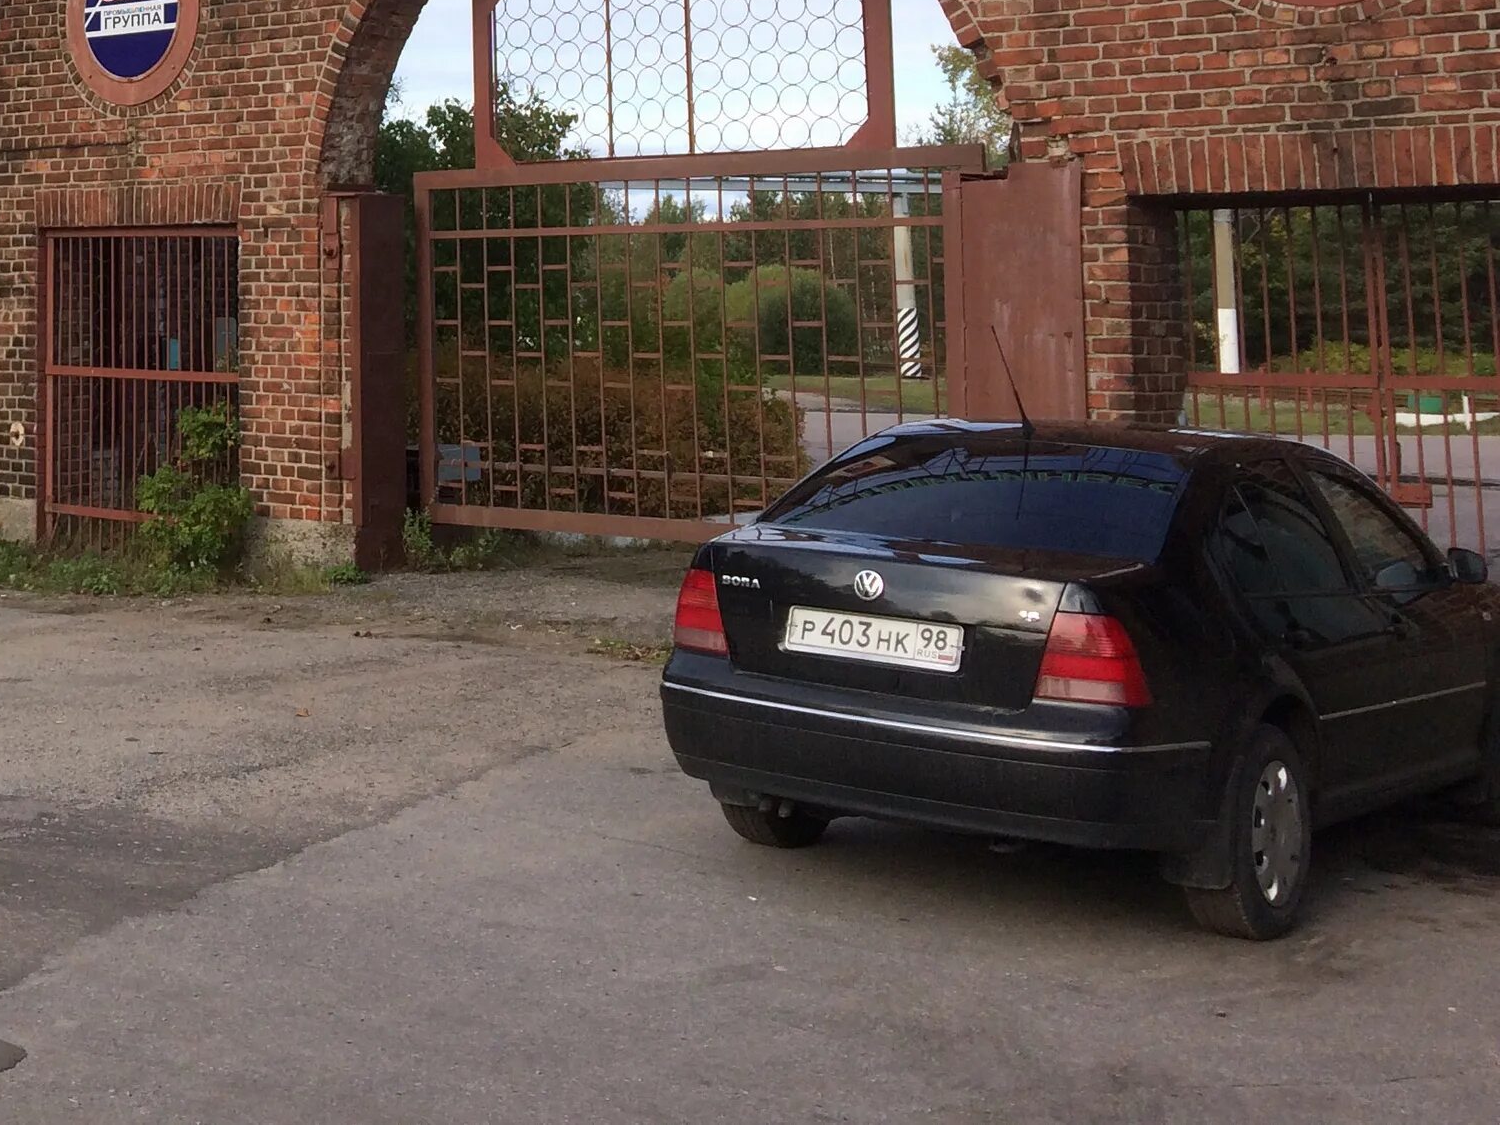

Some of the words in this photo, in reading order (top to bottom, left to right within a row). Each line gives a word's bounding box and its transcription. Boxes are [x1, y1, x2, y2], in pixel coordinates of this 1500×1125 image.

[103, 11, 163, 30] ГРУППА
[722, 574, 761, 589] BORA
[920, 627, 949, 652] 98
[916, 649, 938, 660] RUS
